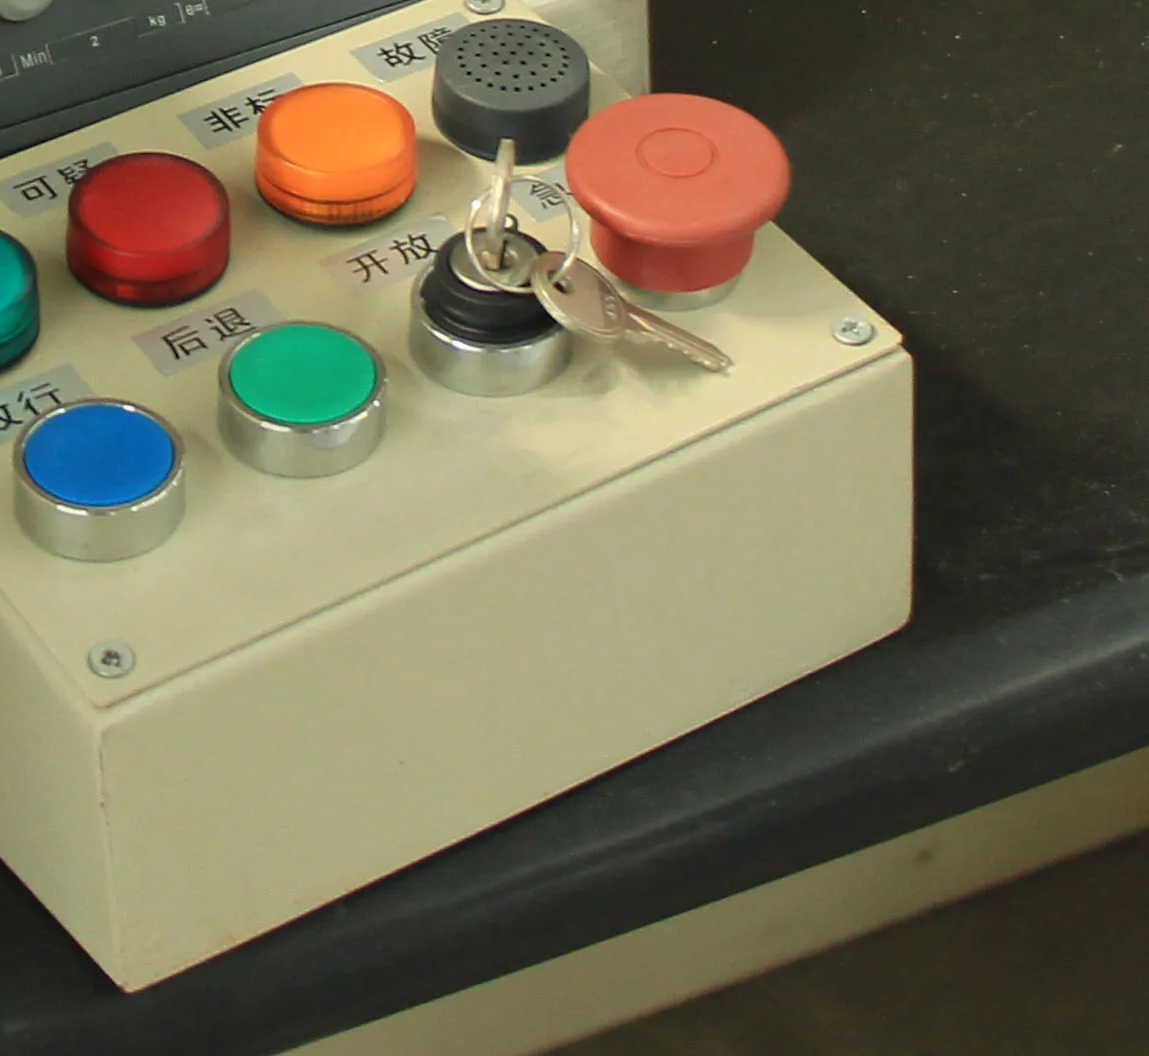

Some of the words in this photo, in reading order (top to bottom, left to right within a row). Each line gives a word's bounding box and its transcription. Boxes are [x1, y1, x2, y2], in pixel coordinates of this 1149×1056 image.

[90, 34, 100, 47] 2
[148, 14, 167, 27] kg
[345, 232, 440, 284] 开放
[161, 307, 257, 360] 后退
